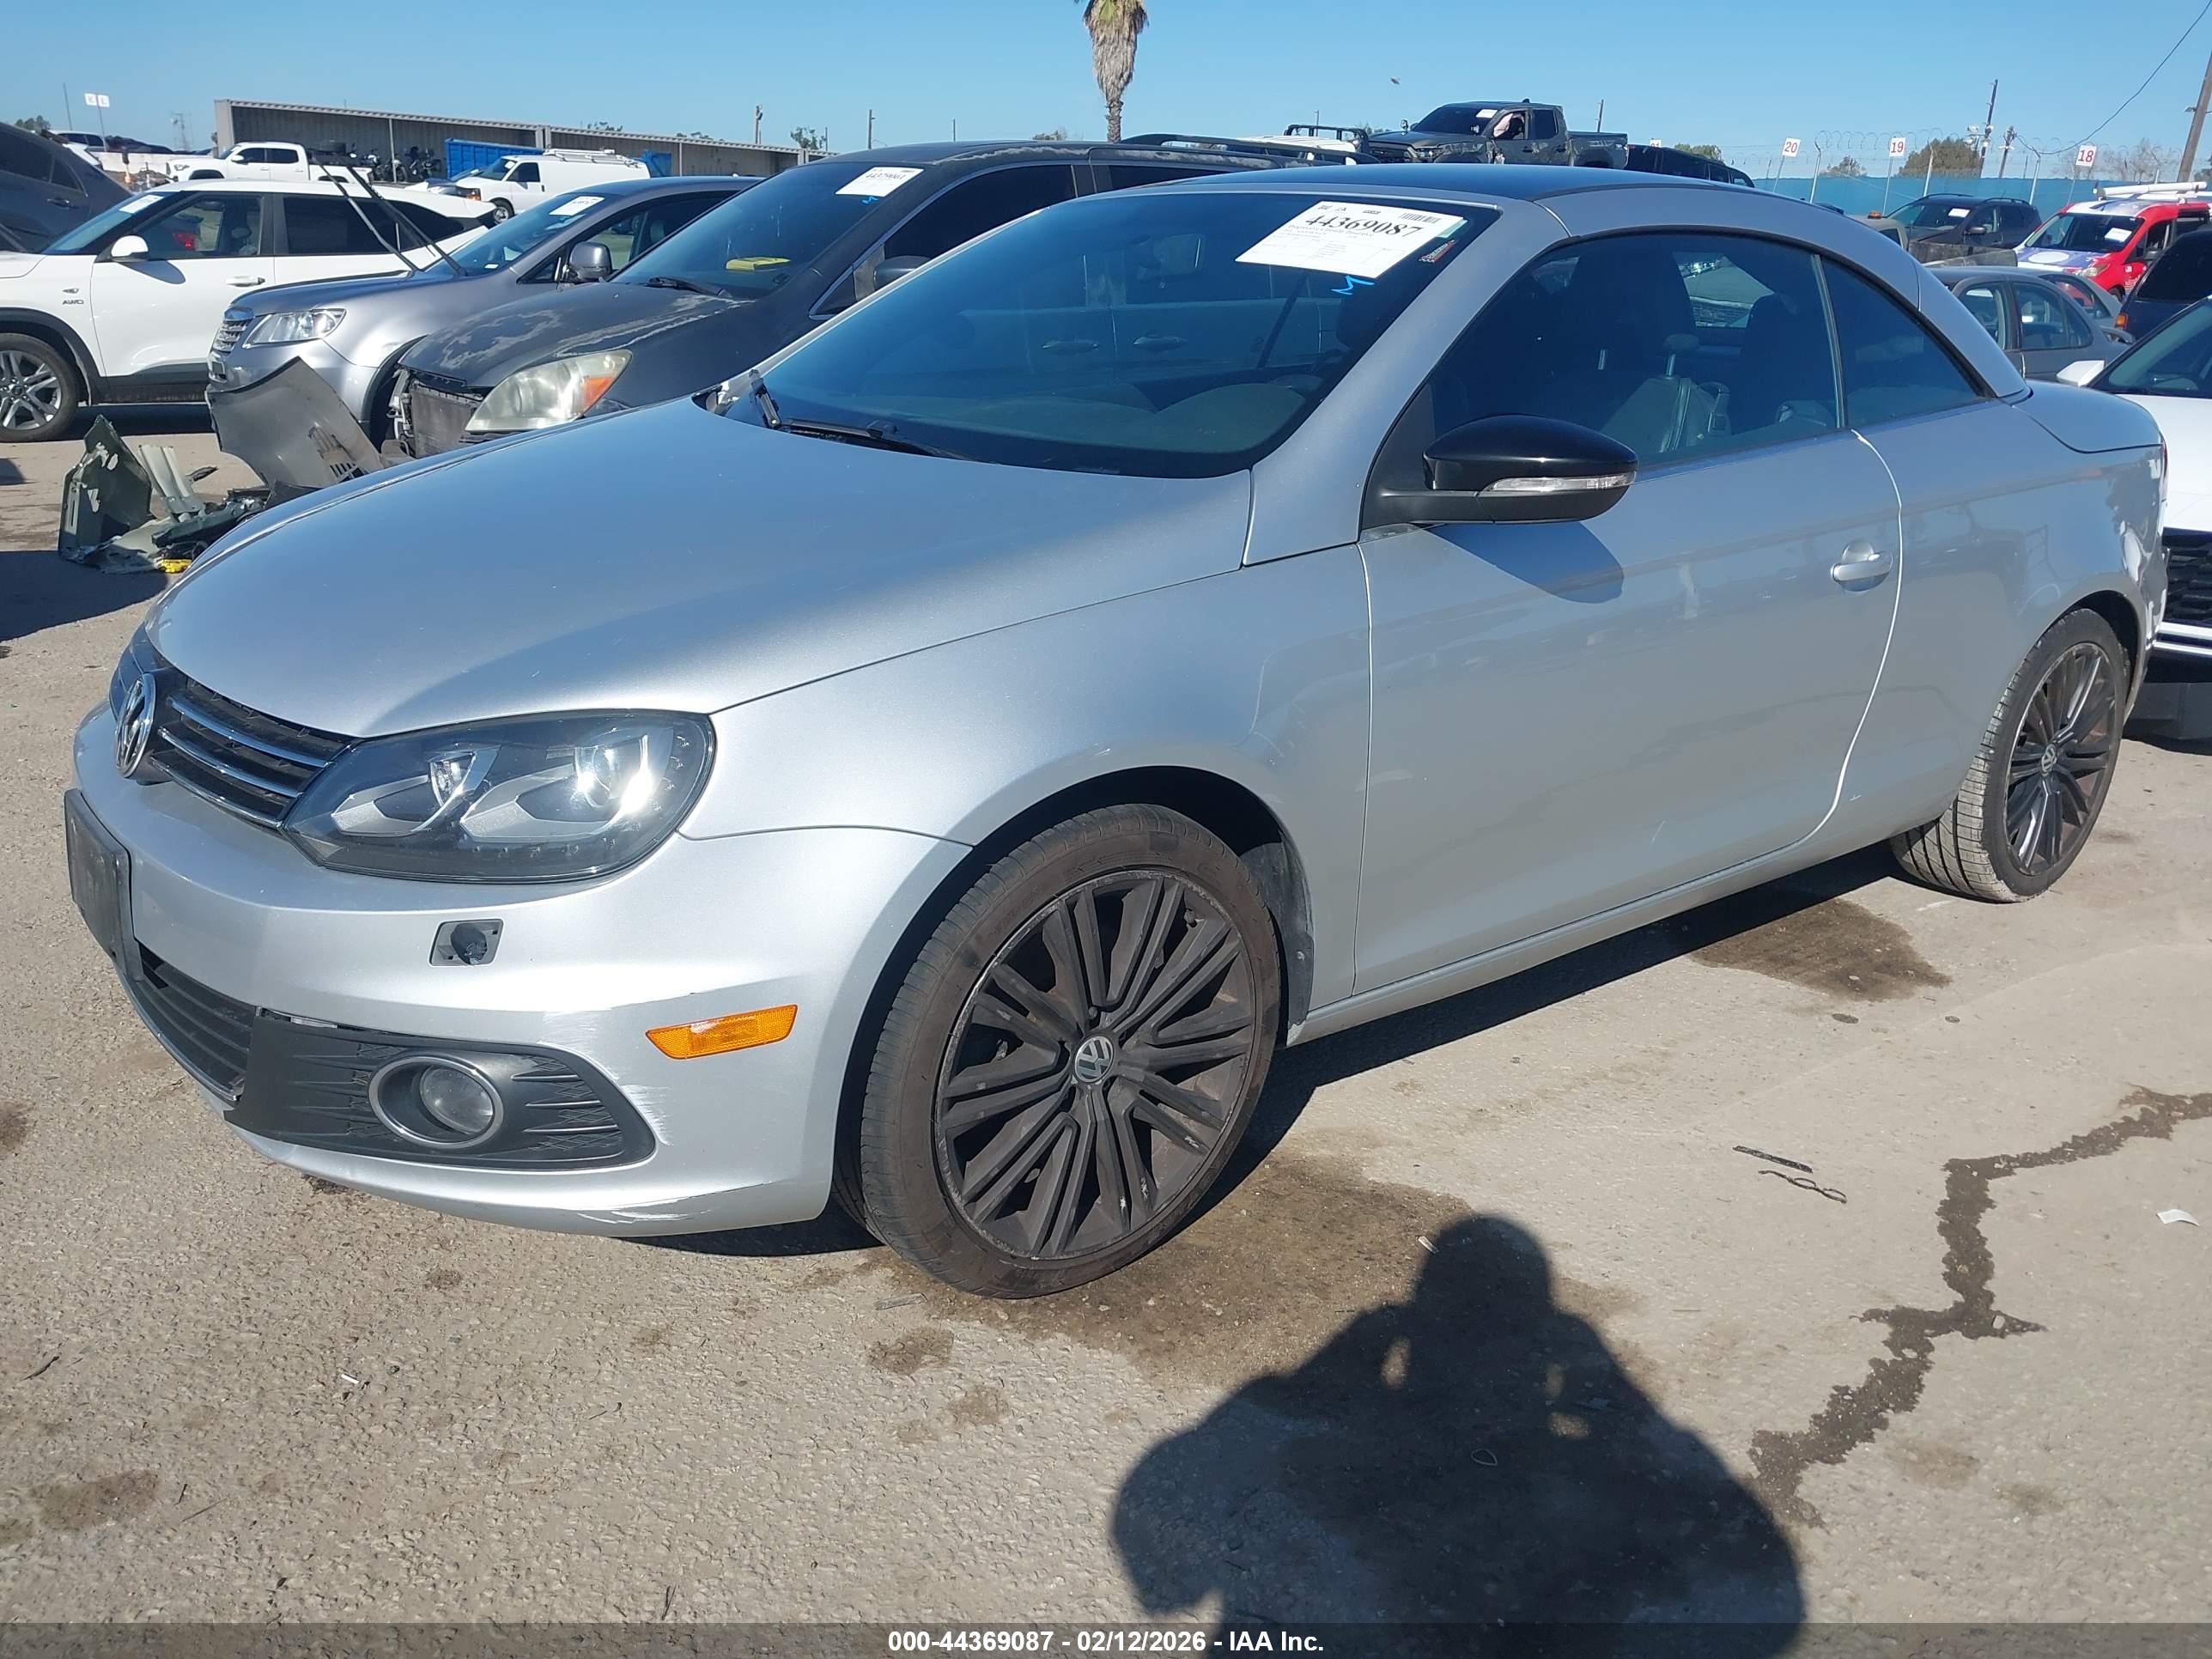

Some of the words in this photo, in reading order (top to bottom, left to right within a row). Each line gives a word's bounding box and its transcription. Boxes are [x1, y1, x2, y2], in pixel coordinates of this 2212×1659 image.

[1784, 142, 1798, 153] 20
[1891, 141, 1904, 153] 19
[2078, 149, 2094, 162] 18
[1305, 215, 1425, 238] 44369087
